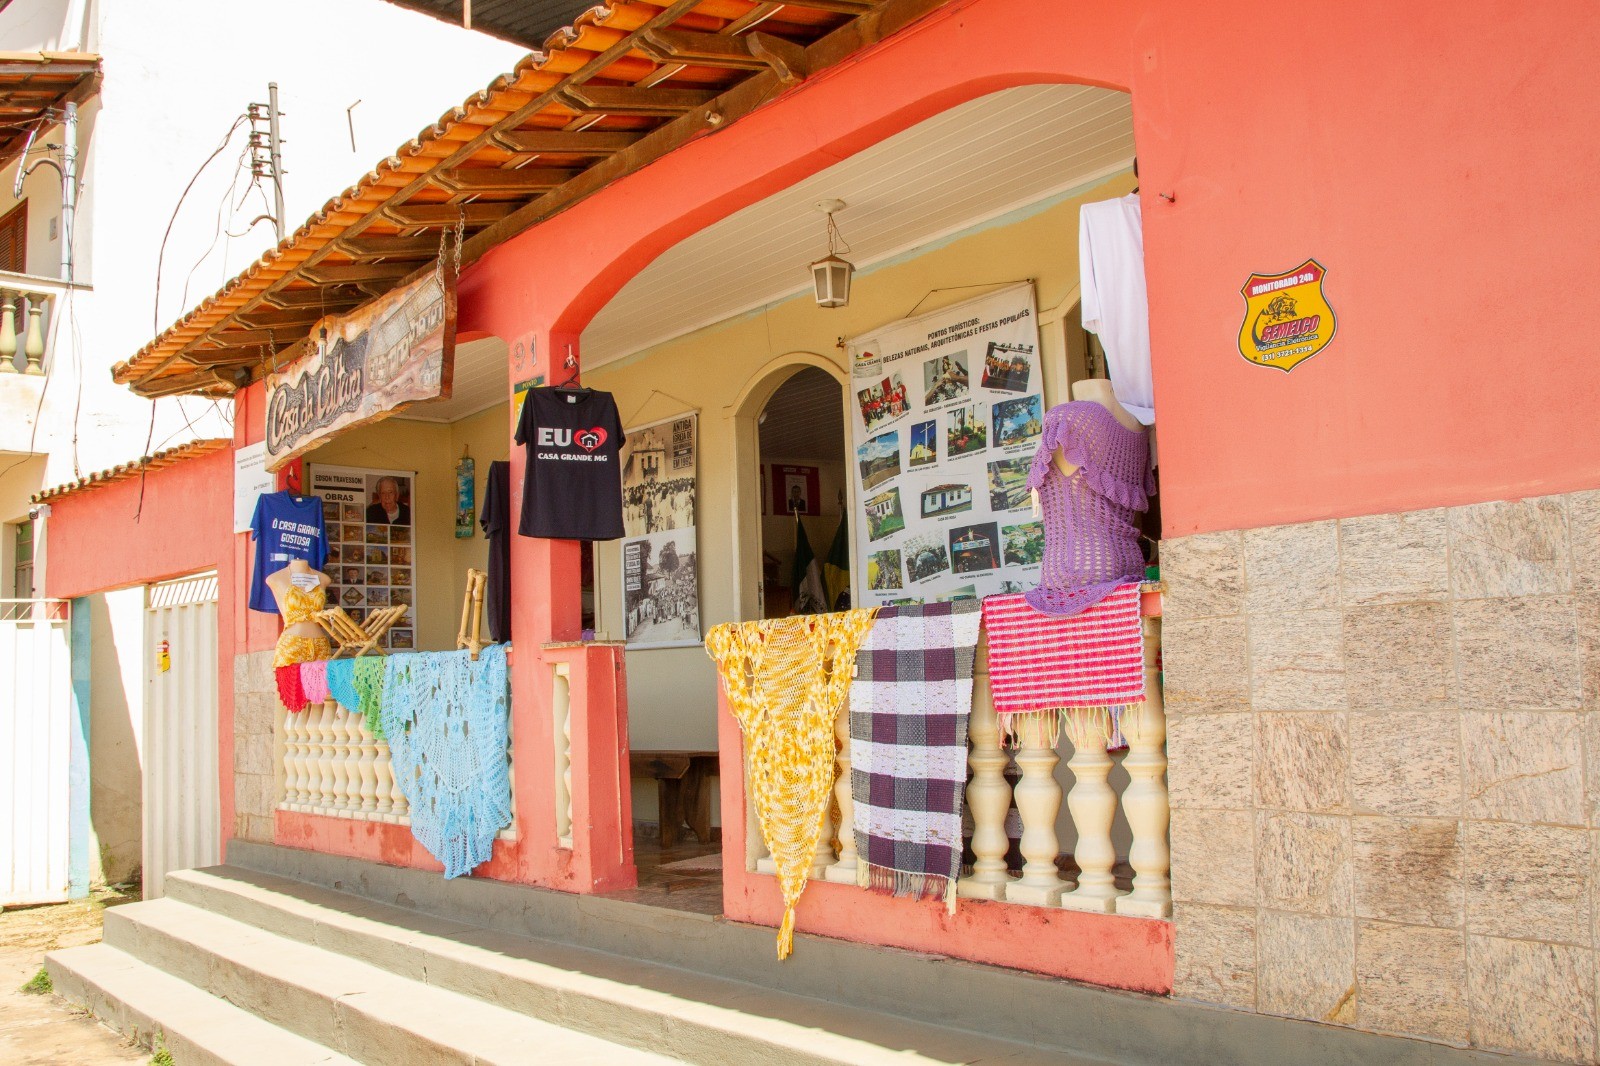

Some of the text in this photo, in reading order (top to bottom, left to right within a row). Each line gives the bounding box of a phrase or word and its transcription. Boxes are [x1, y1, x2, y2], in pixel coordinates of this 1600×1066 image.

[1252, 273, 1314, 295] MONITORADO 24h
[927, 317, 980, 340] PONTOS TURÍSTICOS:
[1261, 315, 1320, 342] SEMELCO
[883, 351, 904, 364] BELEZAS
[904, 343, 930, 358] NATURAIS,
[974, 327, 978, 335] E
[979, 320, 998, 334] FESTAS
[271, 388, 300, 447] Casa
[538, 427, 572, 447] EU
[538, 452, 559, 460] CASA
[561, 453, 592, 462] GRANDE
[315, 474, 333, 483] EDSON
[325, 493, 354, 501] OBRAS
[278, 520, 297, 532] CASA
[281, 532, 311, 547] GOSTOSA
